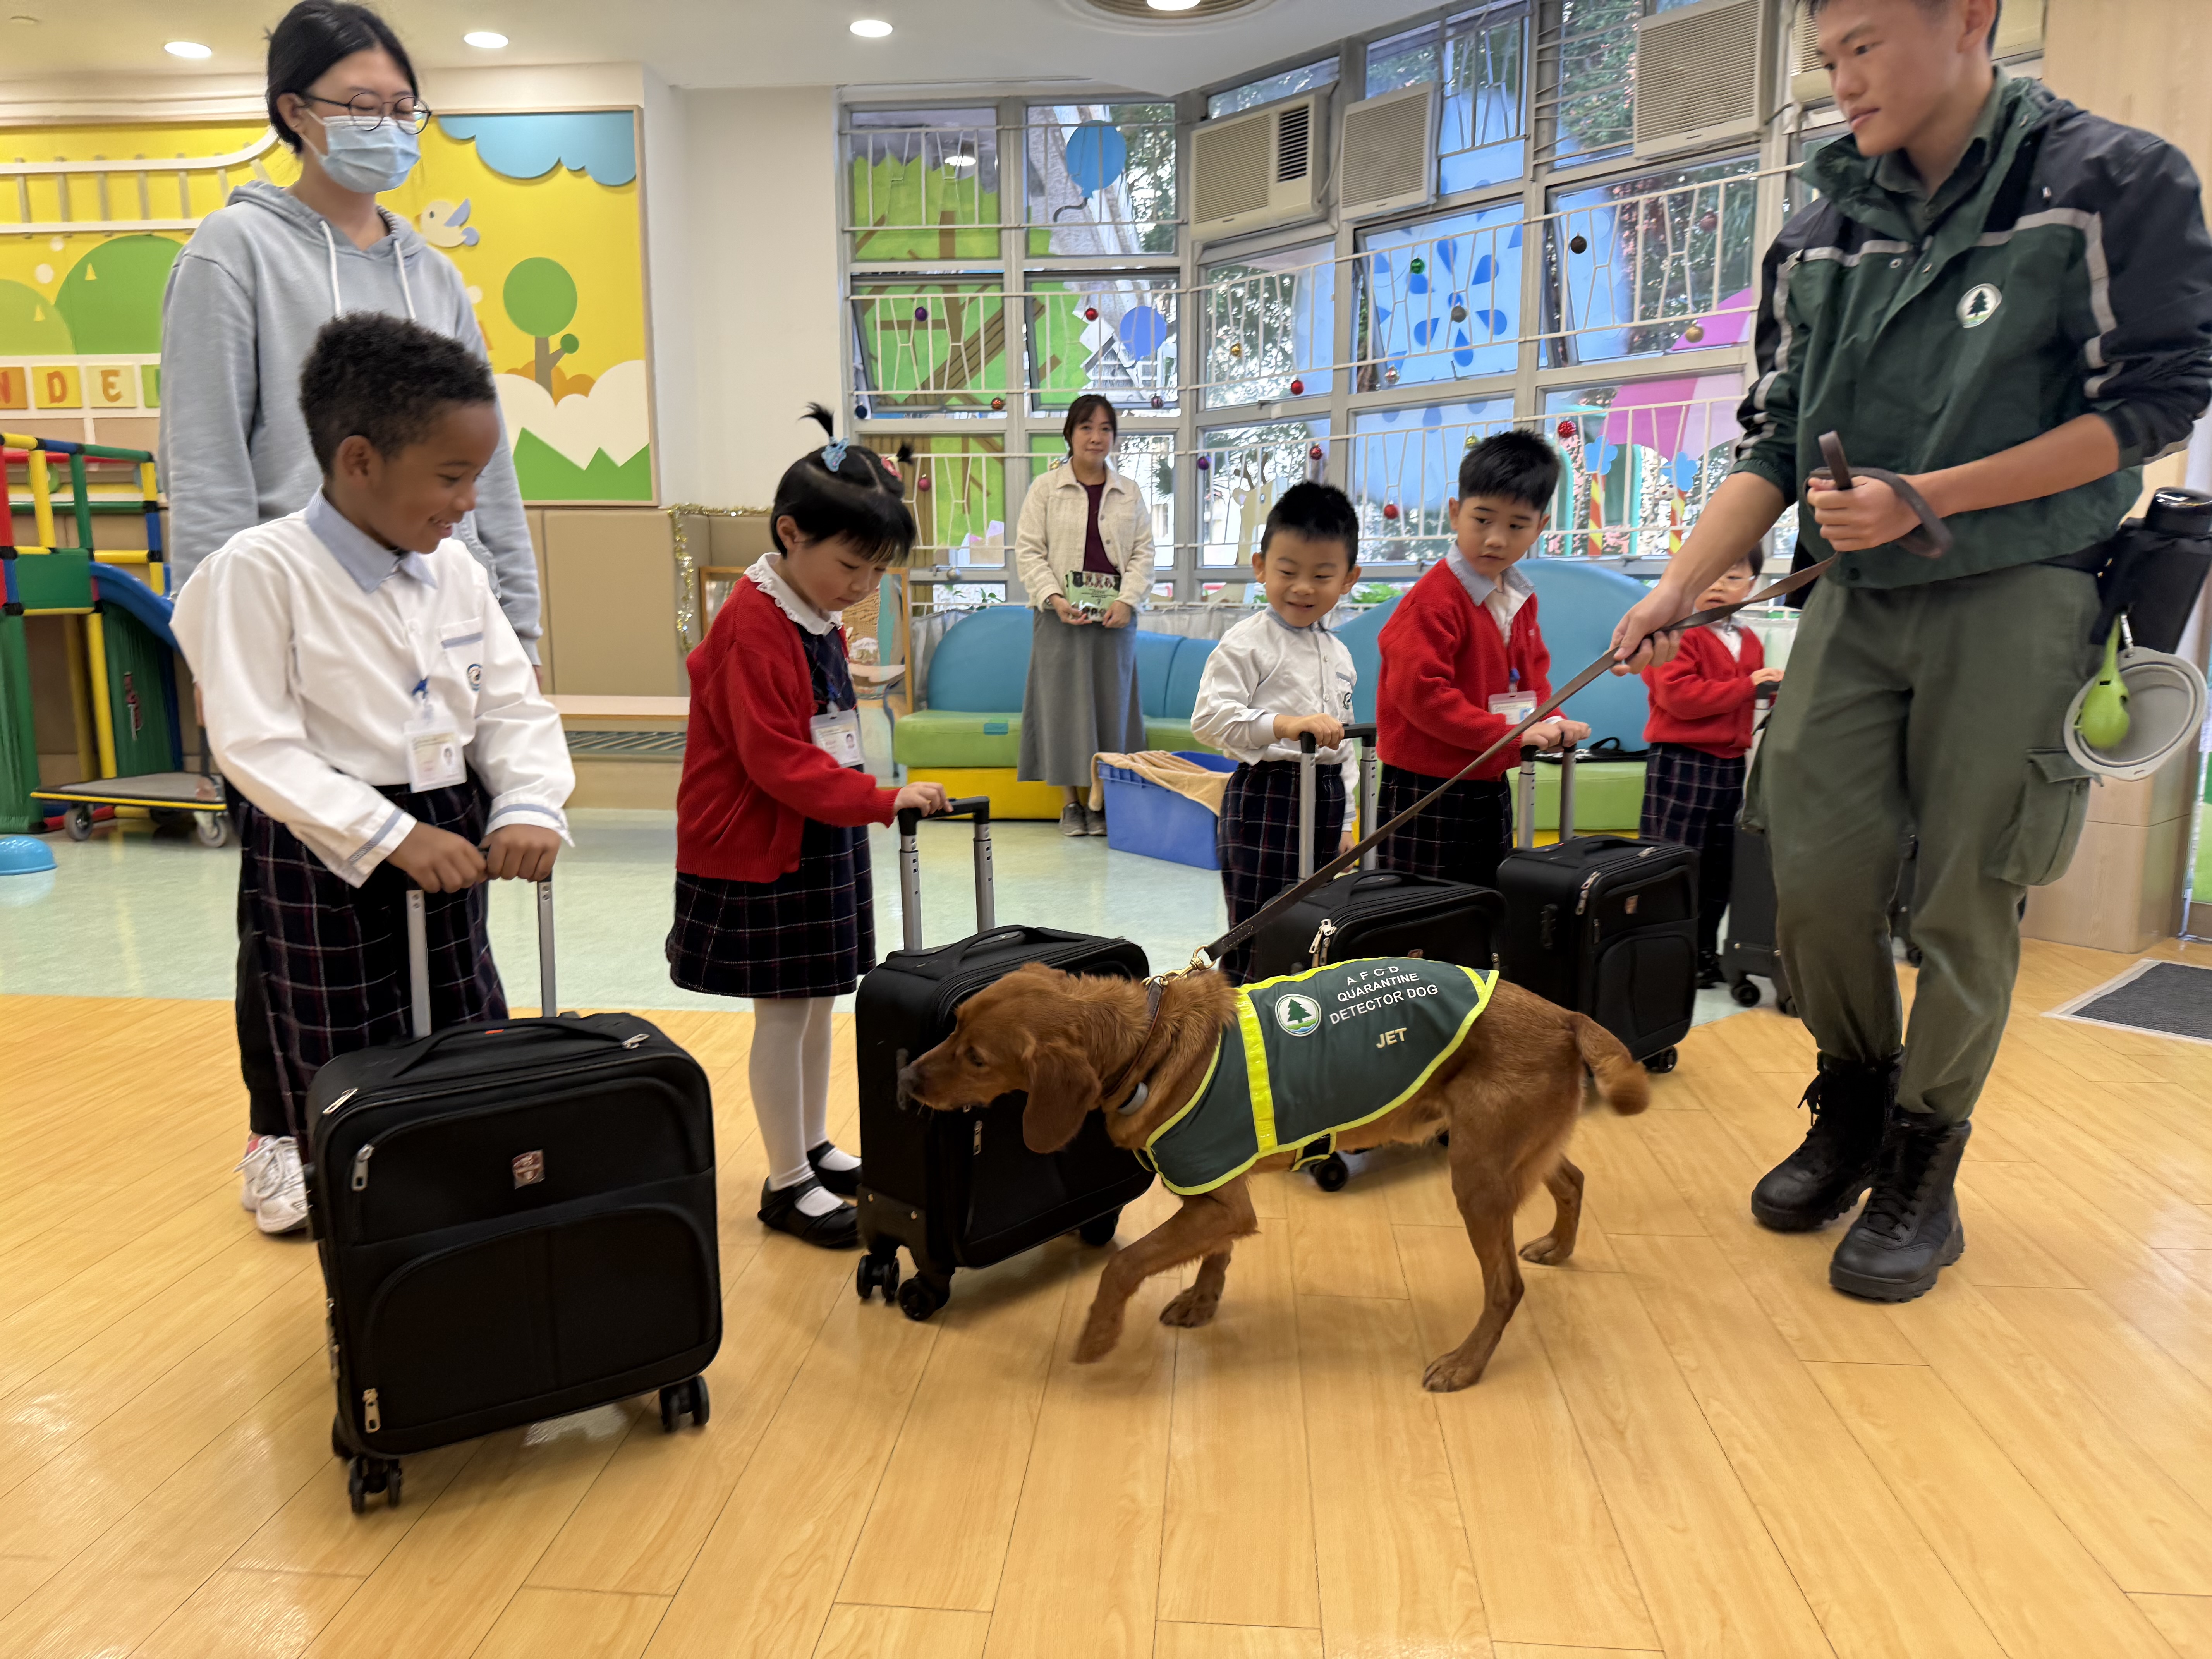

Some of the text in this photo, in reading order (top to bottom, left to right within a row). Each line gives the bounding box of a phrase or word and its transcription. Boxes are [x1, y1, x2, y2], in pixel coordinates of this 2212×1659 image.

[1337, 973, 1420, 1002] QUARANTINE
[1329, 984, 1438, 1025] DETECTOR DOG
[1376, 1027, 1407, 1048] JET
